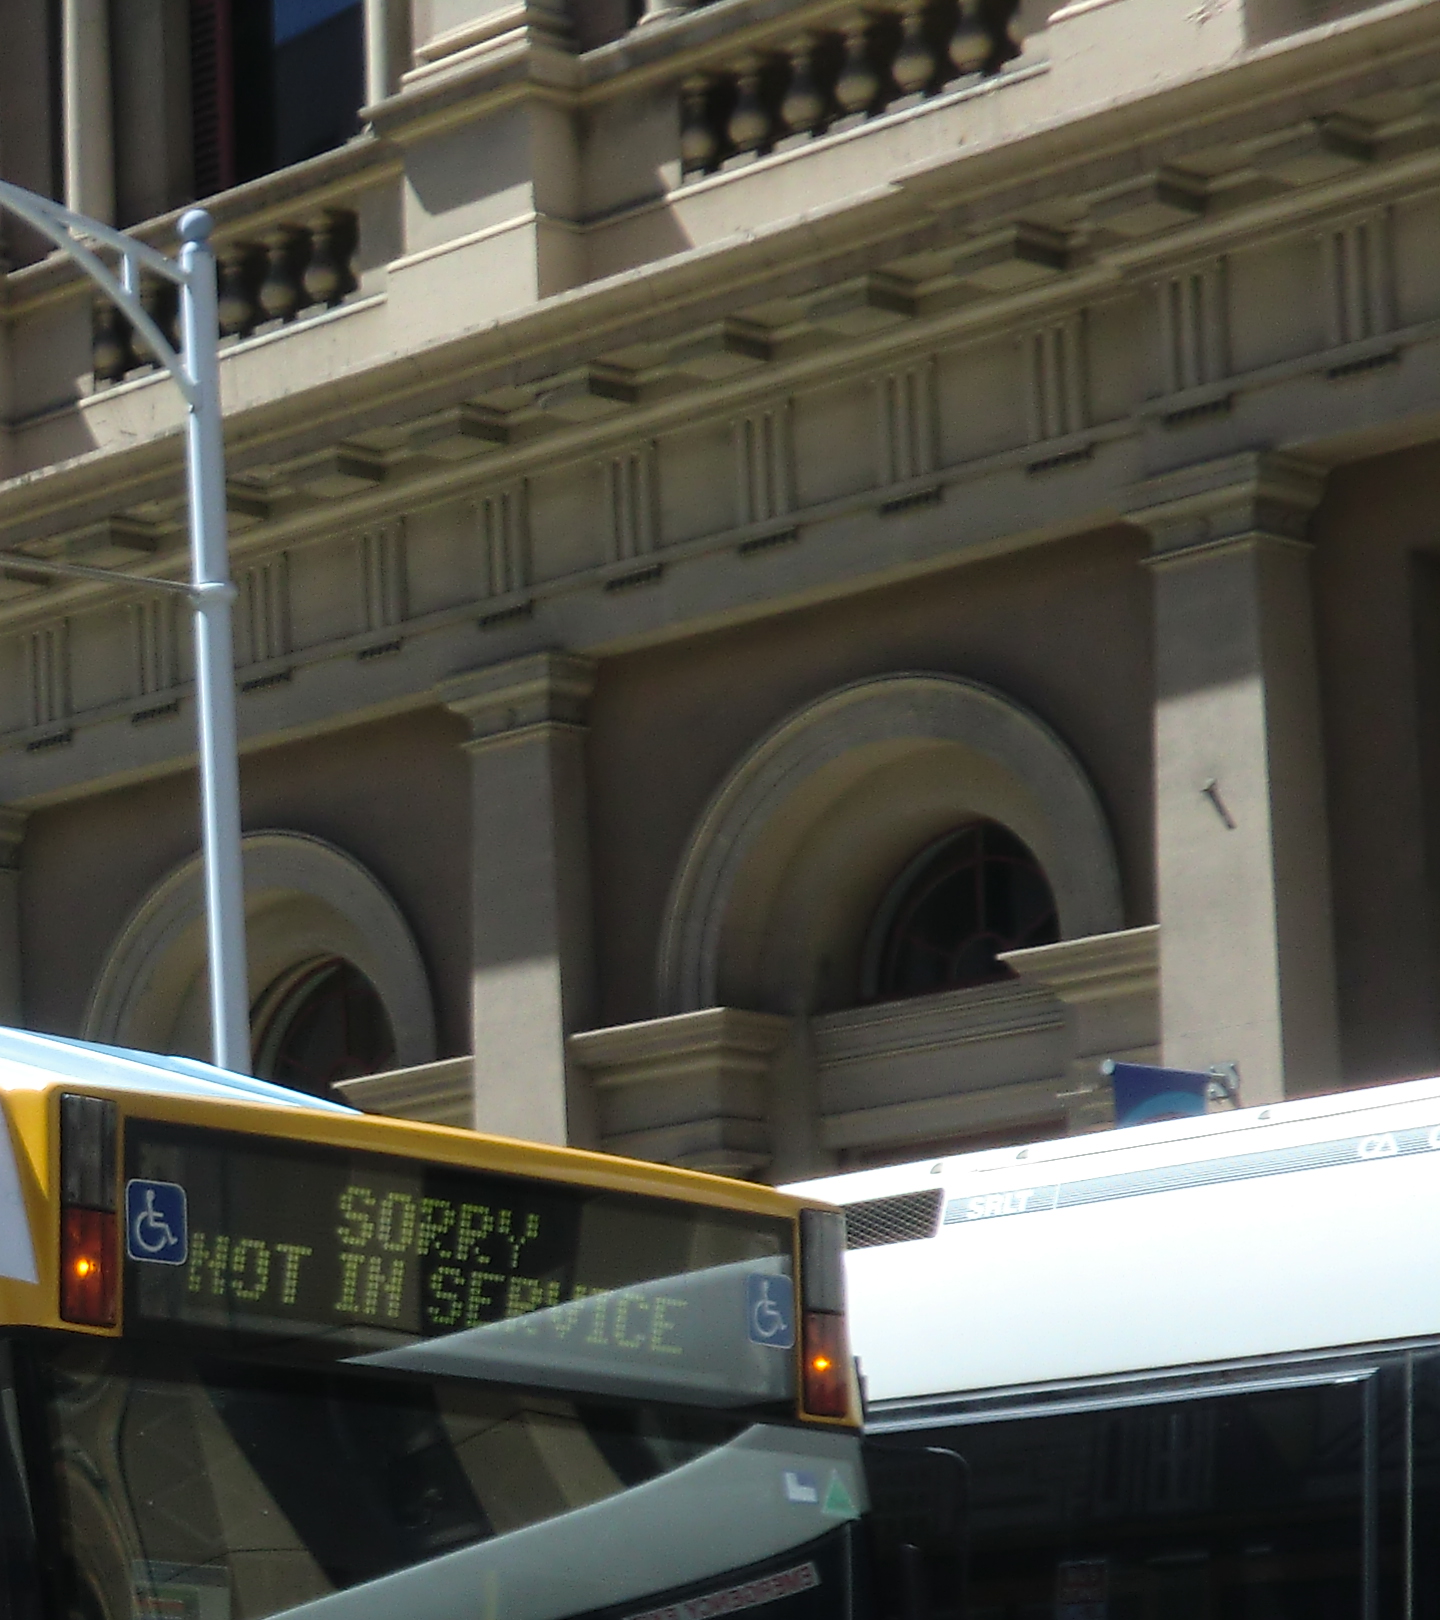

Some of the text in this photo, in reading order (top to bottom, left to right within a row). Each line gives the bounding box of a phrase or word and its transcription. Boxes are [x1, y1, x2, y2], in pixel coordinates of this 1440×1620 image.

[336, 1186, 540, 1268] SORRY
[187, 1232, 689, 1355] NOT IN SERVICE
